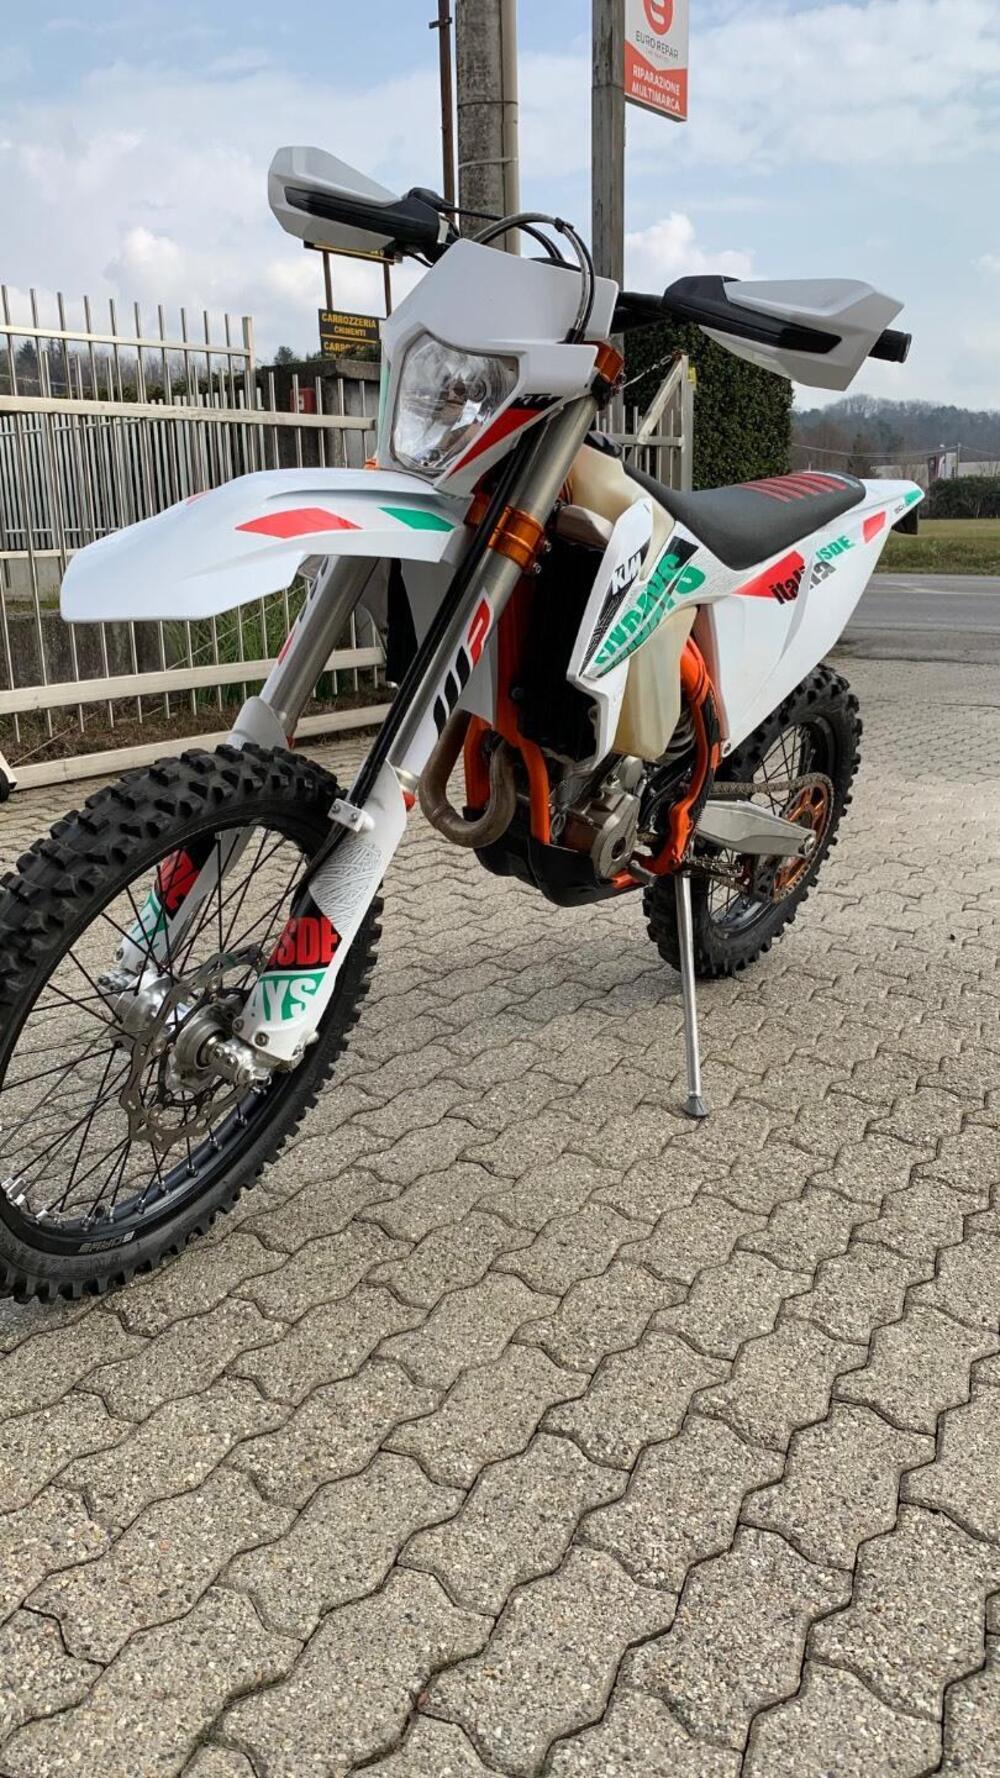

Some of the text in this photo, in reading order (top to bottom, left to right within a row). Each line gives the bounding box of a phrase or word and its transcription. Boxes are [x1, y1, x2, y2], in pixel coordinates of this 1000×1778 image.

[632, 64, 680, 96] RIPARAZIONE
[631, 81, 681, 111] MULTIMARCA
[321, 313, 376, 328] CARROZZERIA
